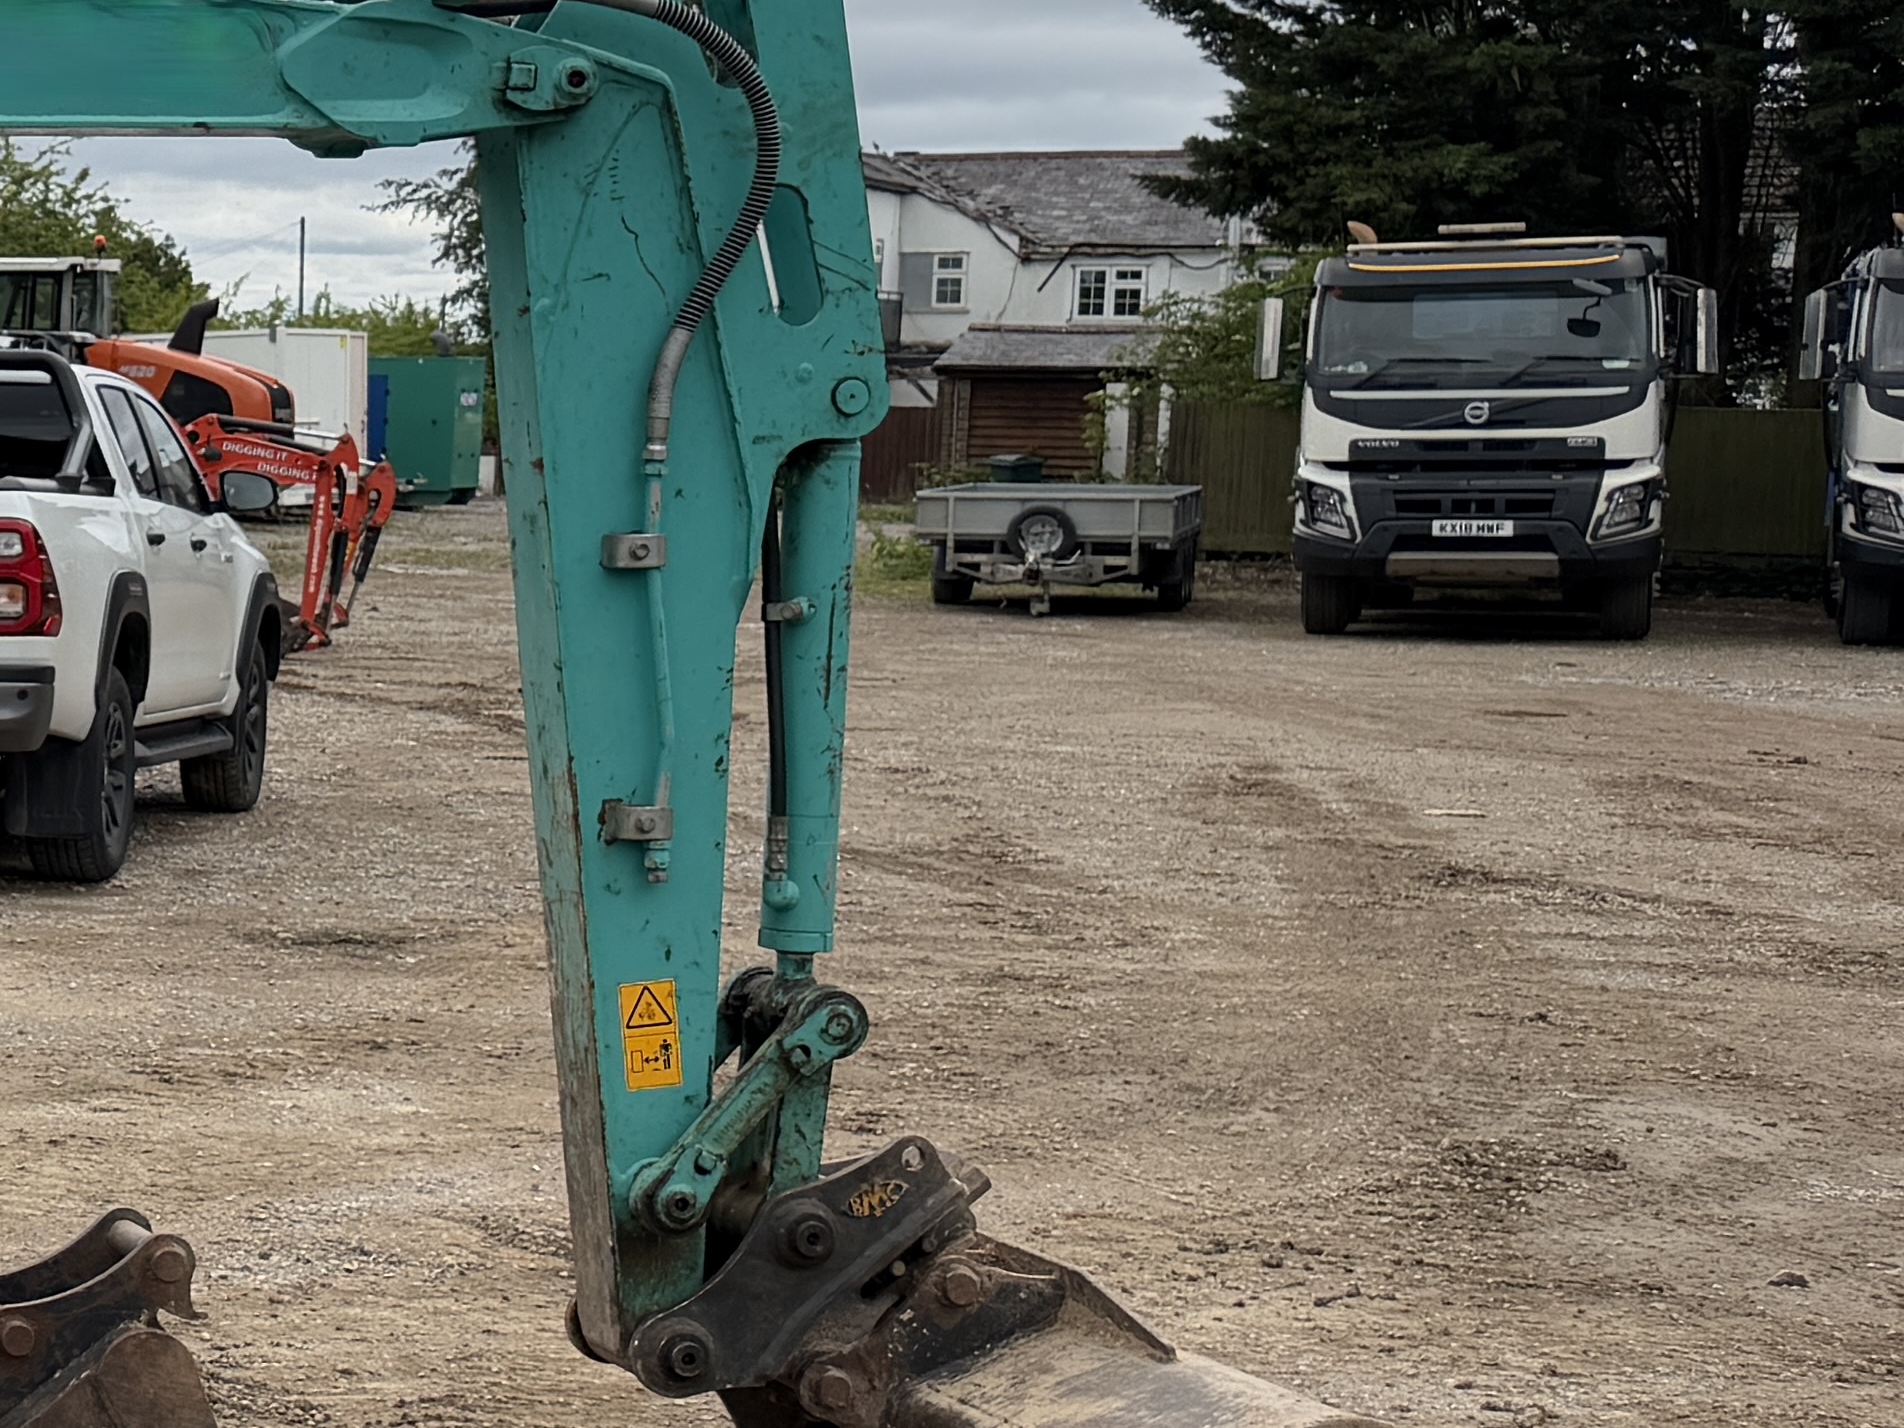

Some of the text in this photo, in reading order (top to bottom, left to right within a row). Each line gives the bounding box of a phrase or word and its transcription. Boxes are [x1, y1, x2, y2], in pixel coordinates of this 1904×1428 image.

[222, 441, 288, 461] DIGGING IT
[257, 462, 309, 480] DIGGING
